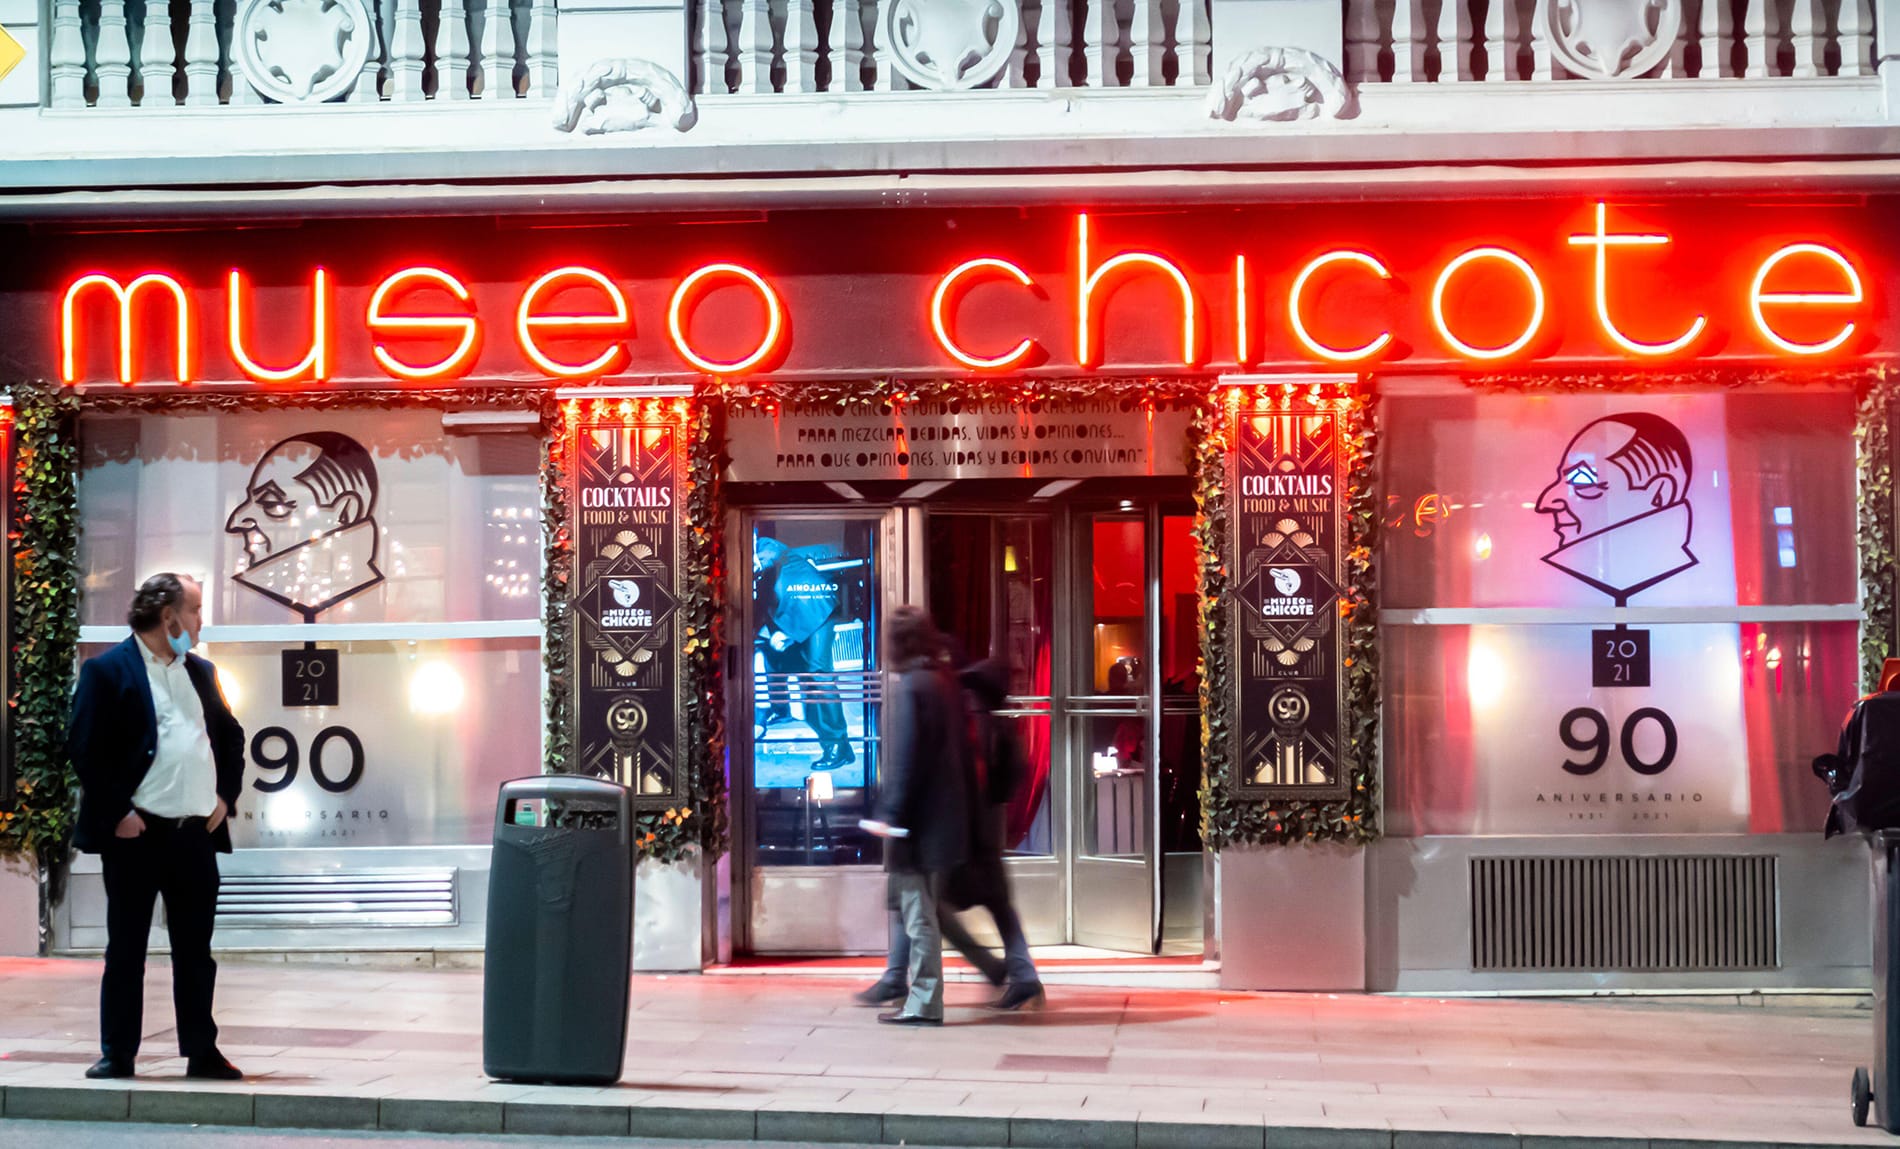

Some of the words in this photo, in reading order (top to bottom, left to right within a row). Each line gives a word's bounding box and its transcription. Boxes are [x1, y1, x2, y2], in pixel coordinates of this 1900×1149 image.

[61, 262, 785, 385] museo
[930, 202, 1864, 371] chicote
[851, 401, 907, 417] CHICOTE
[798, 427, 837, 442] PARA
[841, 427, 905, 442] MEZCLAR
[976, 425, 1016, 440] VIDAS
[1020, 425, 1030, 440] Y
[776, 453, 815, 468] PARA
[820, 452, 851, 467] QUE
[943, 451, 983, 466] VIDAS
[987, 451, 996, 465] Y
[1001, 450, 1059, 465] BEBIDAS
[1242, 475, 1332, 496] COCKTAILS
[582, 487, 671, 508] COCKTAILS
[1244, 498, 1276, 513] FOOD
[1279, 498, 1291, 513] &
[1294, 498, 1331, 513] MUSIC
[583, 510, 615, 525] FOOD
[618, 510, 630, 525] &
[633, 510, 670, 525] MUSIC
[1270, 597, 1306, 605] MUSEO
[1262, 605, 1314, 616] CHICOTE
[601, 616, 653, 627] CHICOTE
[1606, 640, 1637, 658] 20
[295, 659, 326, 678] 20
[1613, 664, 1631, 681] 21
[303, 683, 319, 700] 21
[1277, 696, 1301, 719] 90
[615, 707, 639, 730] 90
[1559, 707, 1678, 776] 90
[251, 726, 365, 793] 90
[1536, 793, 1703, 802] ANIVERSARIO
[243, 809, 389, 821] NIRSARIO
